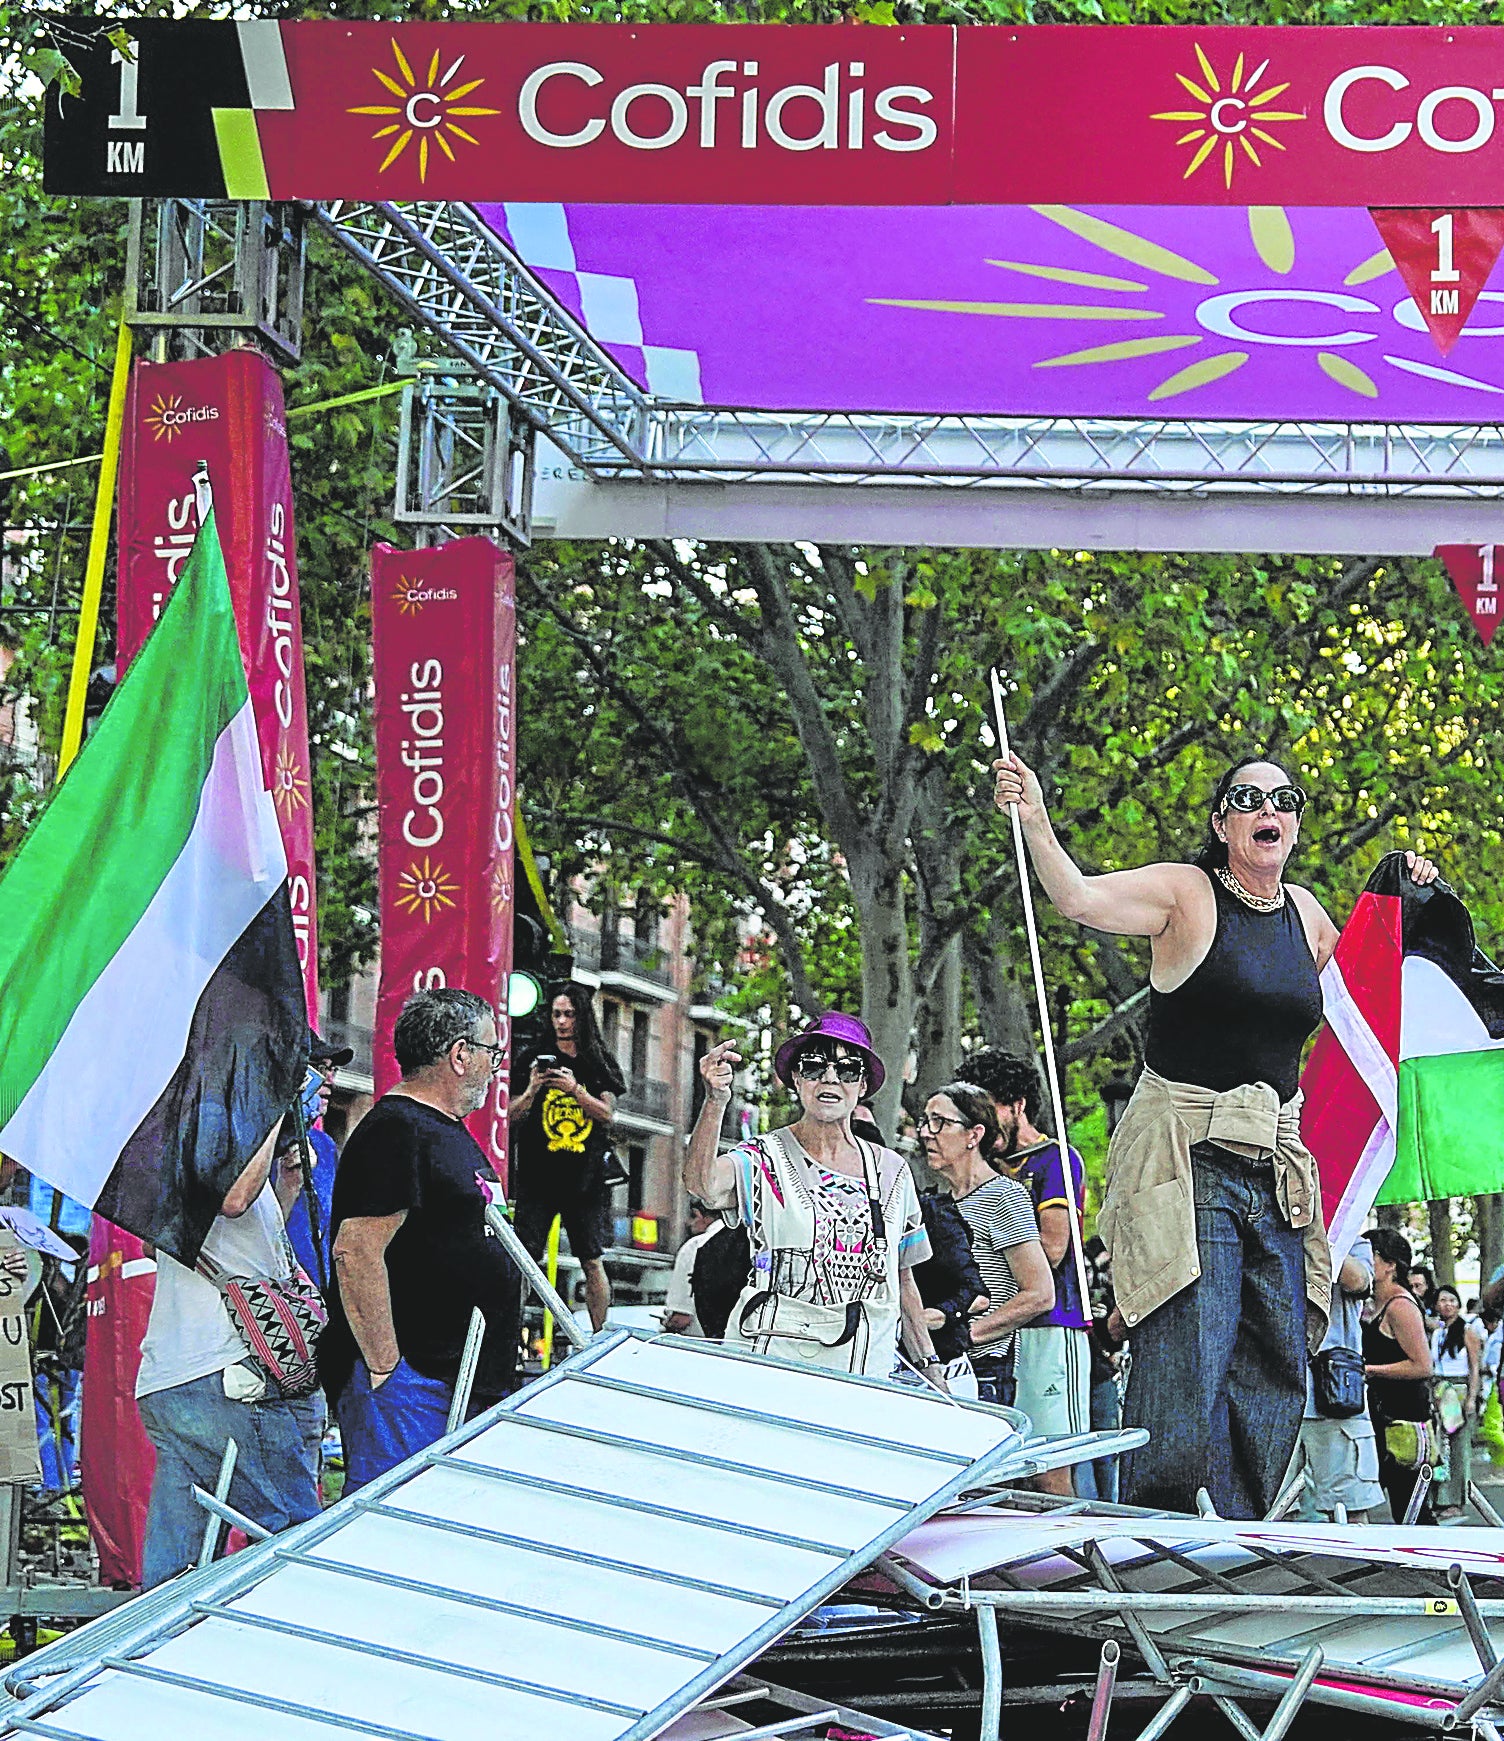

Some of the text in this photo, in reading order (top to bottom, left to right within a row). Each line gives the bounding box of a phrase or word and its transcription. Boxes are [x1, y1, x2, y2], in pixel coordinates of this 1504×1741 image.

[107, 42, 147, 130] 1
[518, 61, 938, 152] Cofidis
[106, 141, 145, 174] KM
[1430, 214, 1460, 282] 1
[1430, 289, 1459, 315] KM
[162, 406, 219, 425] Cofidis
[1477, 544, 1498, 592] 1
[266, 502, 293, 729] Cofidis
[406, 586, 458, 602] Cofidis
[1475, 597, 1497, 615] KM
[400, 658, 444, 848] Cofidis
